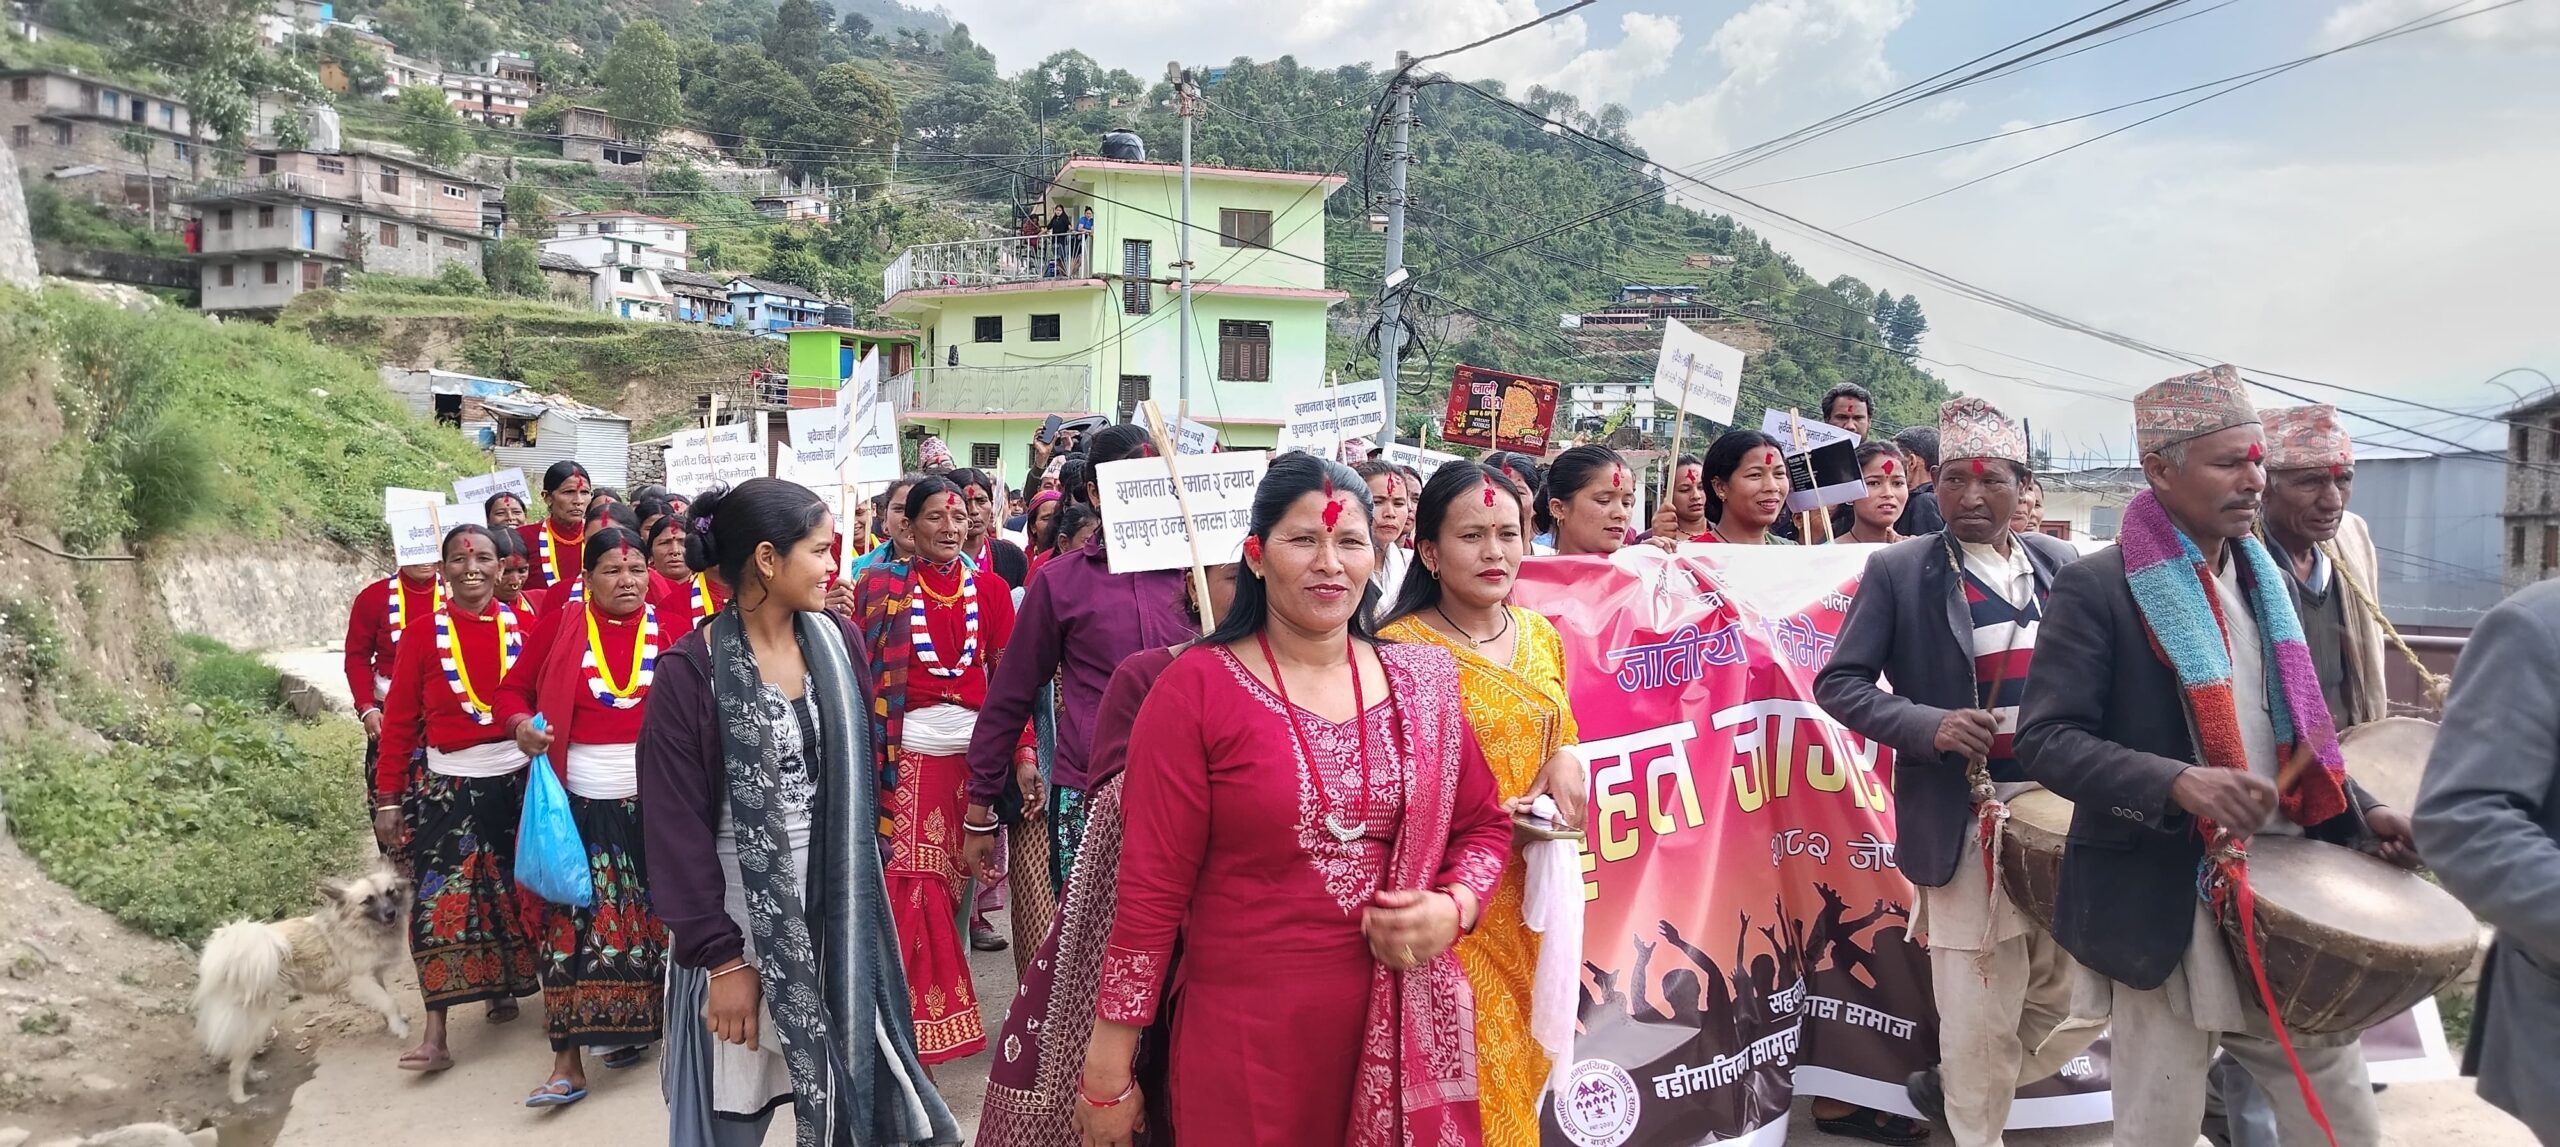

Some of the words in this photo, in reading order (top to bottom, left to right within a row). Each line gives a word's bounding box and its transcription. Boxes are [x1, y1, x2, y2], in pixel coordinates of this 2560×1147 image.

[1294, 400, 1325, 416] समानता
[1358, 391, 1377, 404] न्याय
[1471, 380, 1498, 395] लाली
[1116, 477, 1165, 505] समानता
[1167, 472, 1211, 500] समान
[1222, 469, 1256, 489] न्याय
[1113, 518, 1159, 549] छुवाछुत
[1228, 508, 1252, 529] आध
[1607, 622, 1748, 692] जातीय
[1576, 720, 1705, 902] हत
[1711, 698, 1897, 814] जागर
[1652, 1043, 1750, 1100] बडीमालिका
[1845, 1001, 1917, 1041] समाज
